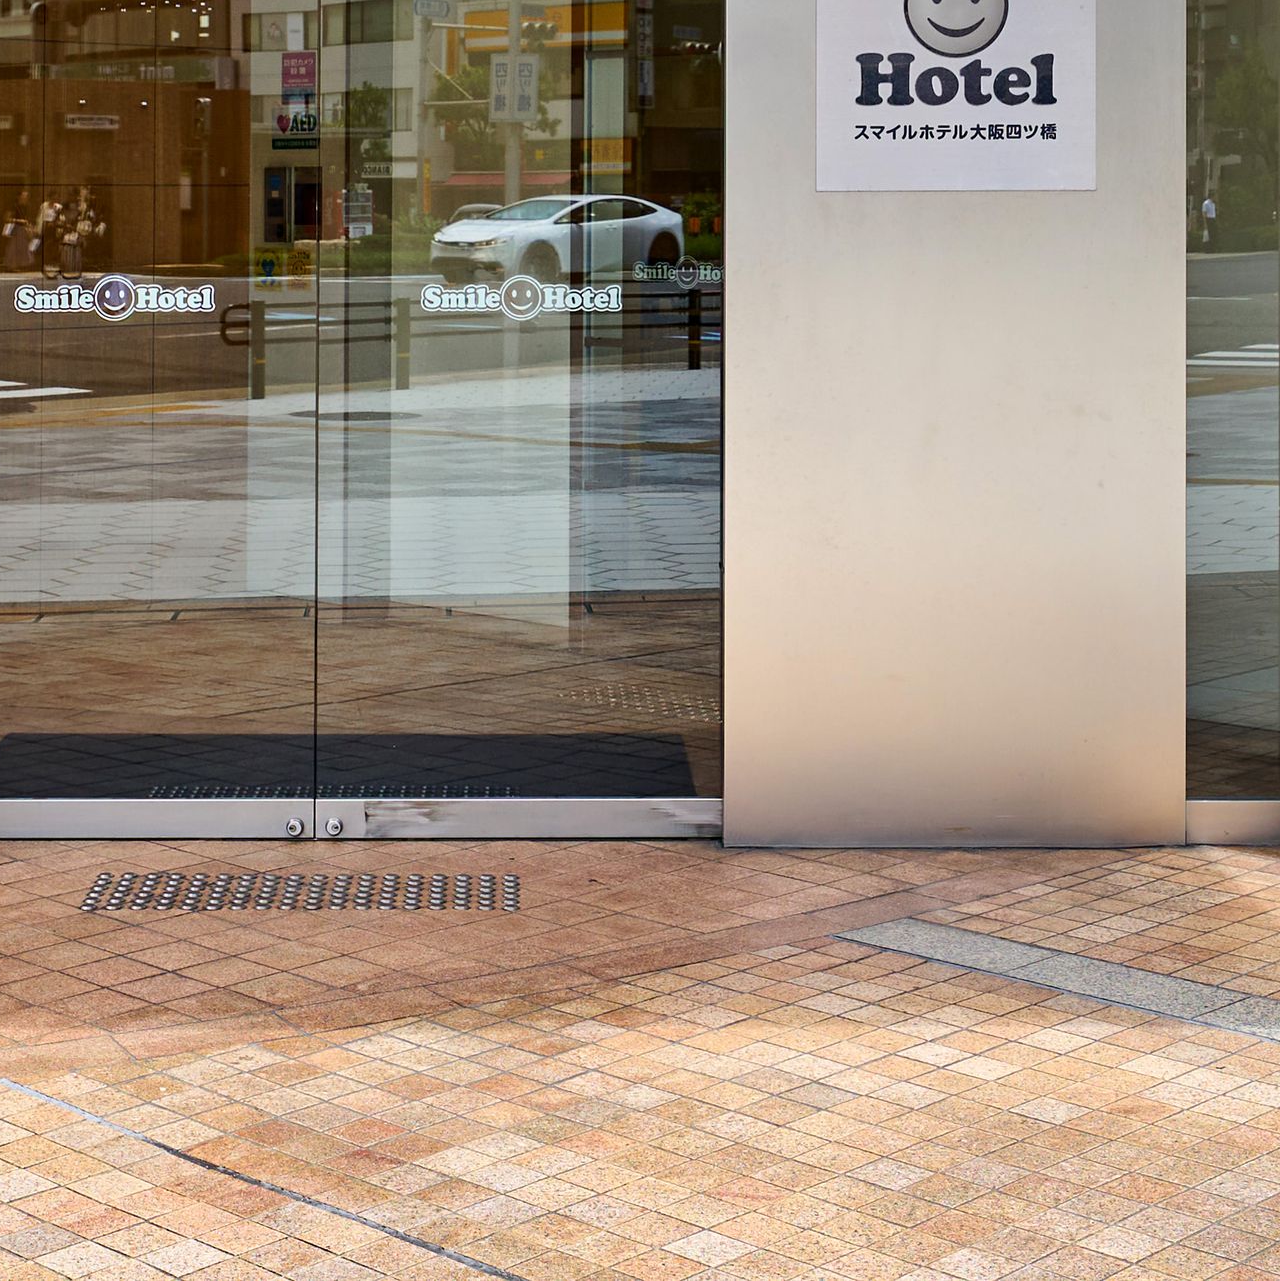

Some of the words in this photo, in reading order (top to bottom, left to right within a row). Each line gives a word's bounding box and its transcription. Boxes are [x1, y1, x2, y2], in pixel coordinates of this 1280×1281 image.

[855, 52, 1058, 106] Hotel
[289, 114, 317, 132] AED
[854, 123, 1058, 141] スマイルホテル大阪四ツ橋
[634, 263, 677, 281] Smile
[699, 264, 724, 281] Ho
[16, 286, 95, 311] Smile
[135, 286, 214, 311] Hotel
[422, 286, 500, 311] Smile
[542, 286, 621, 311] Hotel
